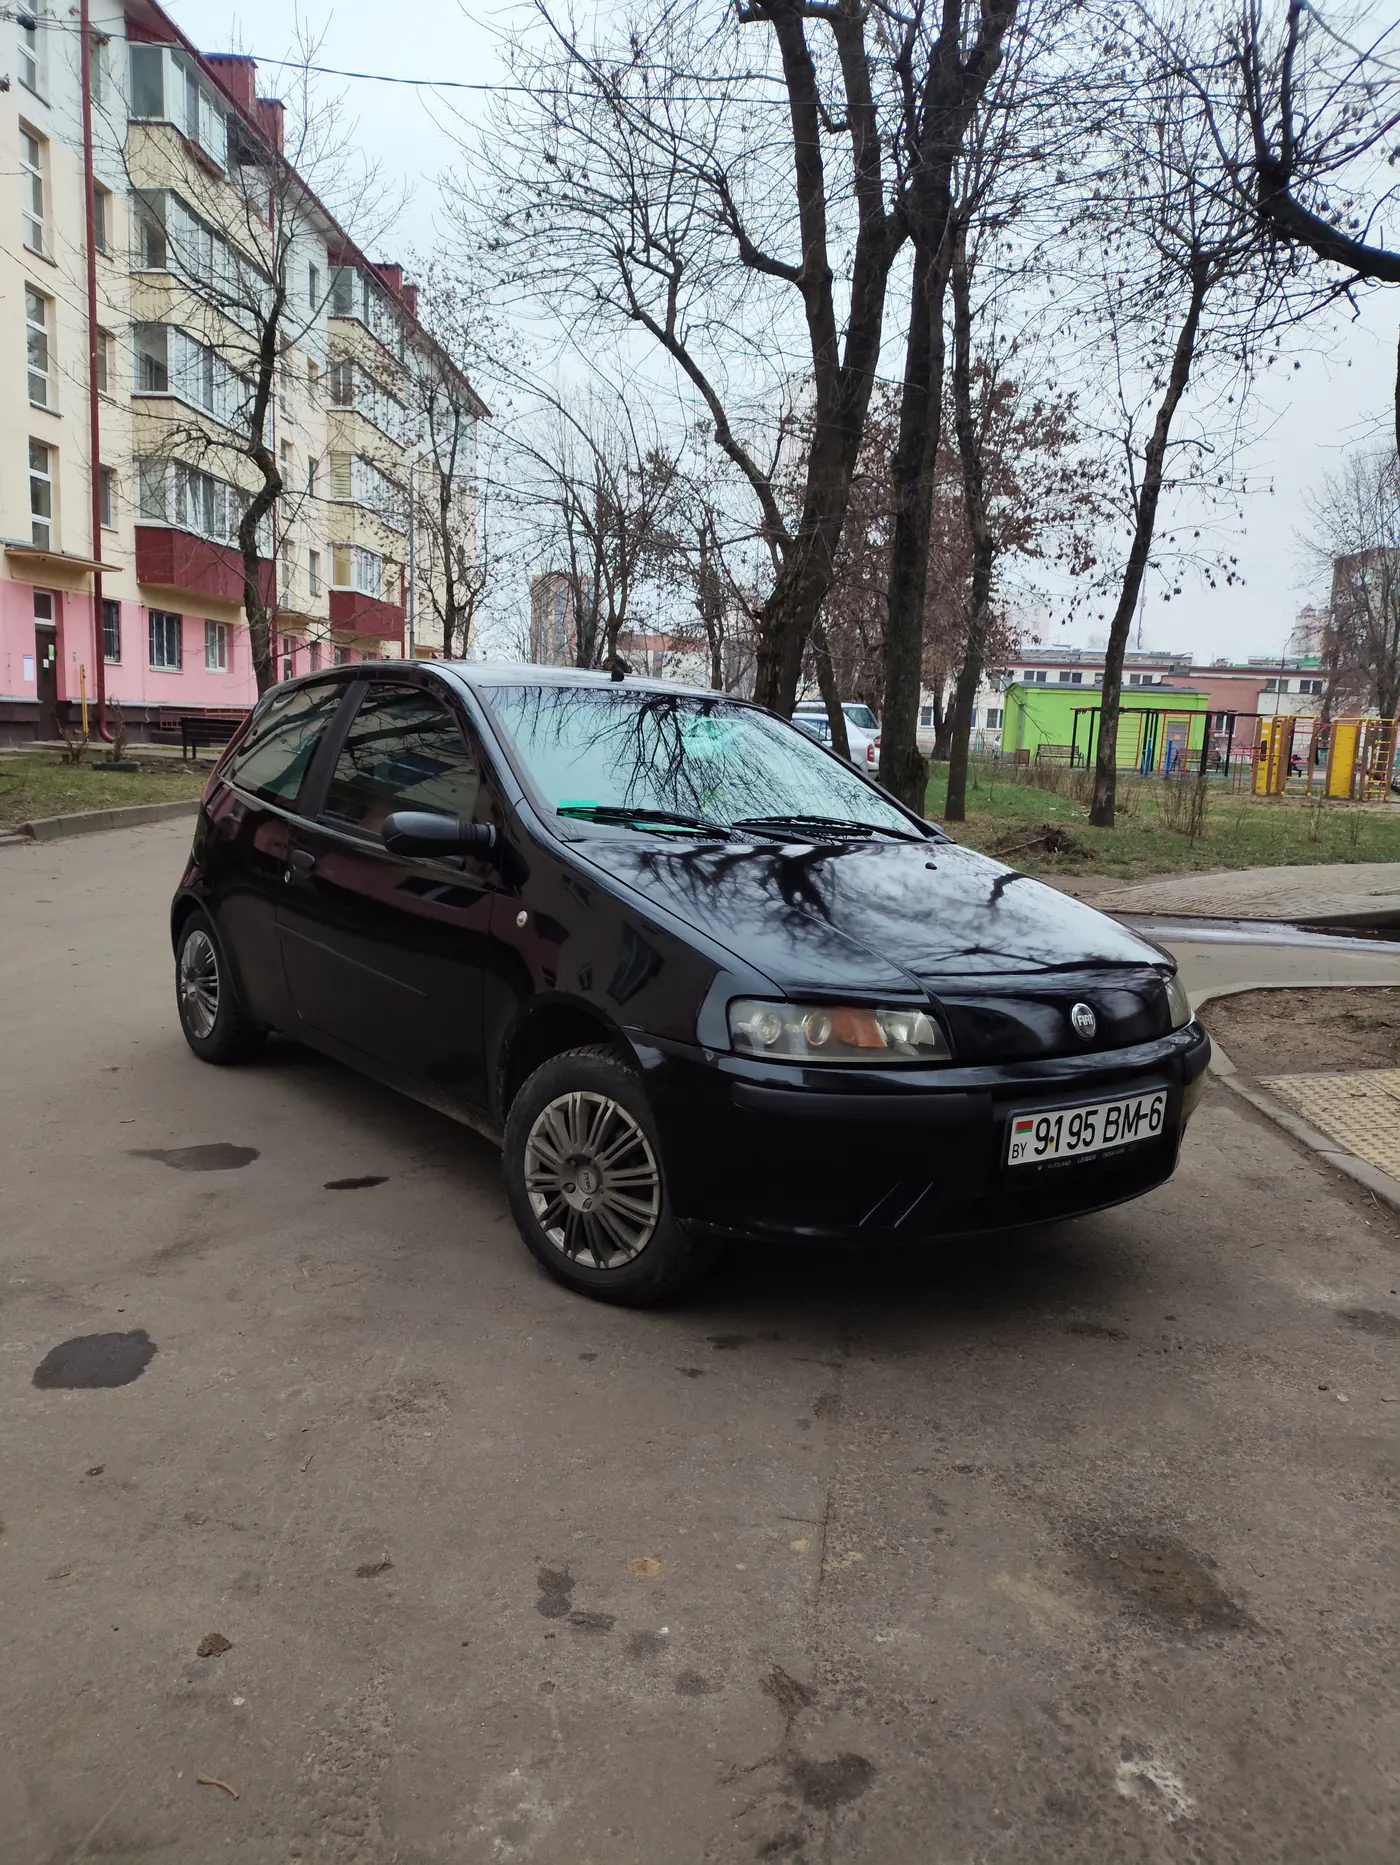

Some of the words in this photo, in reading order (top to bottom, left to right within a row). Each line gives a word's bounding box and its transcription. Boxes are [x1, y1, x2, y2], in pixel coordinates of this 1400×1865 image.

[1077, 1014, 1094, 1026] FIAT
[1033, 1109, 1099, 1156] 9195
[1102, 1096, 1163, 1144] BM-6
[1011, 1142, 1028, 1159] BY
